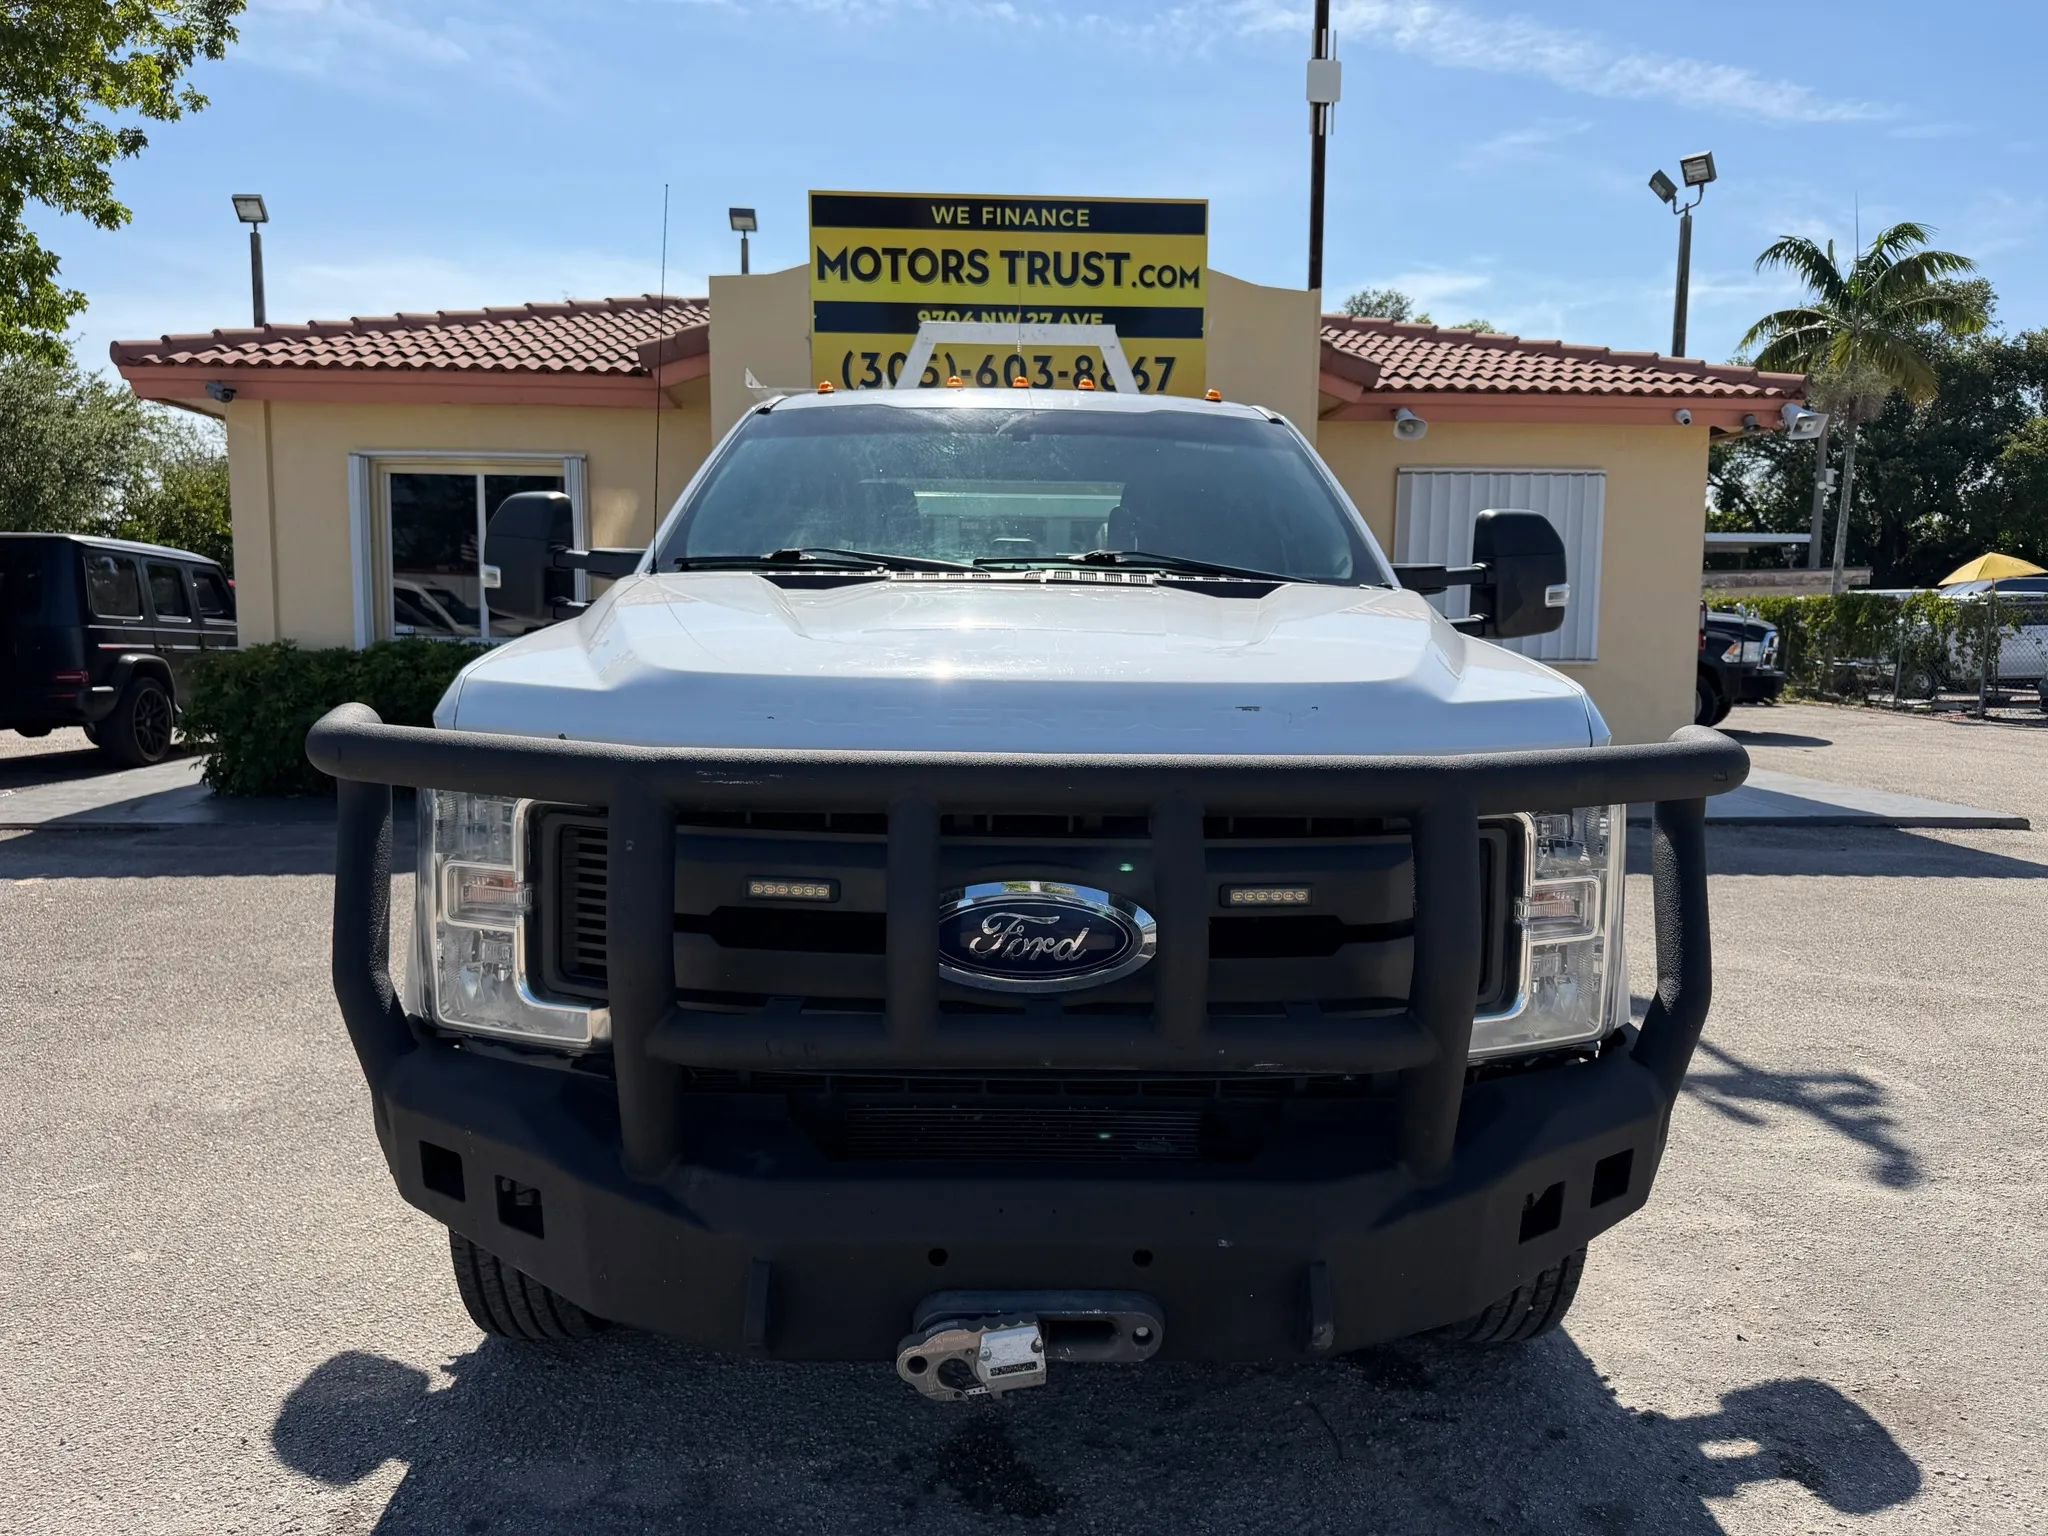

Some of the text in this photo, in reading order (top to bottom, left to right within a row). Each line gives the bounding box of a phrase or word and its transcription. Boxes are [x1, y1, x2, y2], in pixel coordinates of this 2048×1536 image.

[931, 206, 1090, 227] WE FINANCE
[817, 246, 1200, 288] MOTORS TRUST.COM
[981, 312, 1021, 324] NW
[1059, 313, 1104, 325] AVE
[969, 912, 1090, 961] Ford
